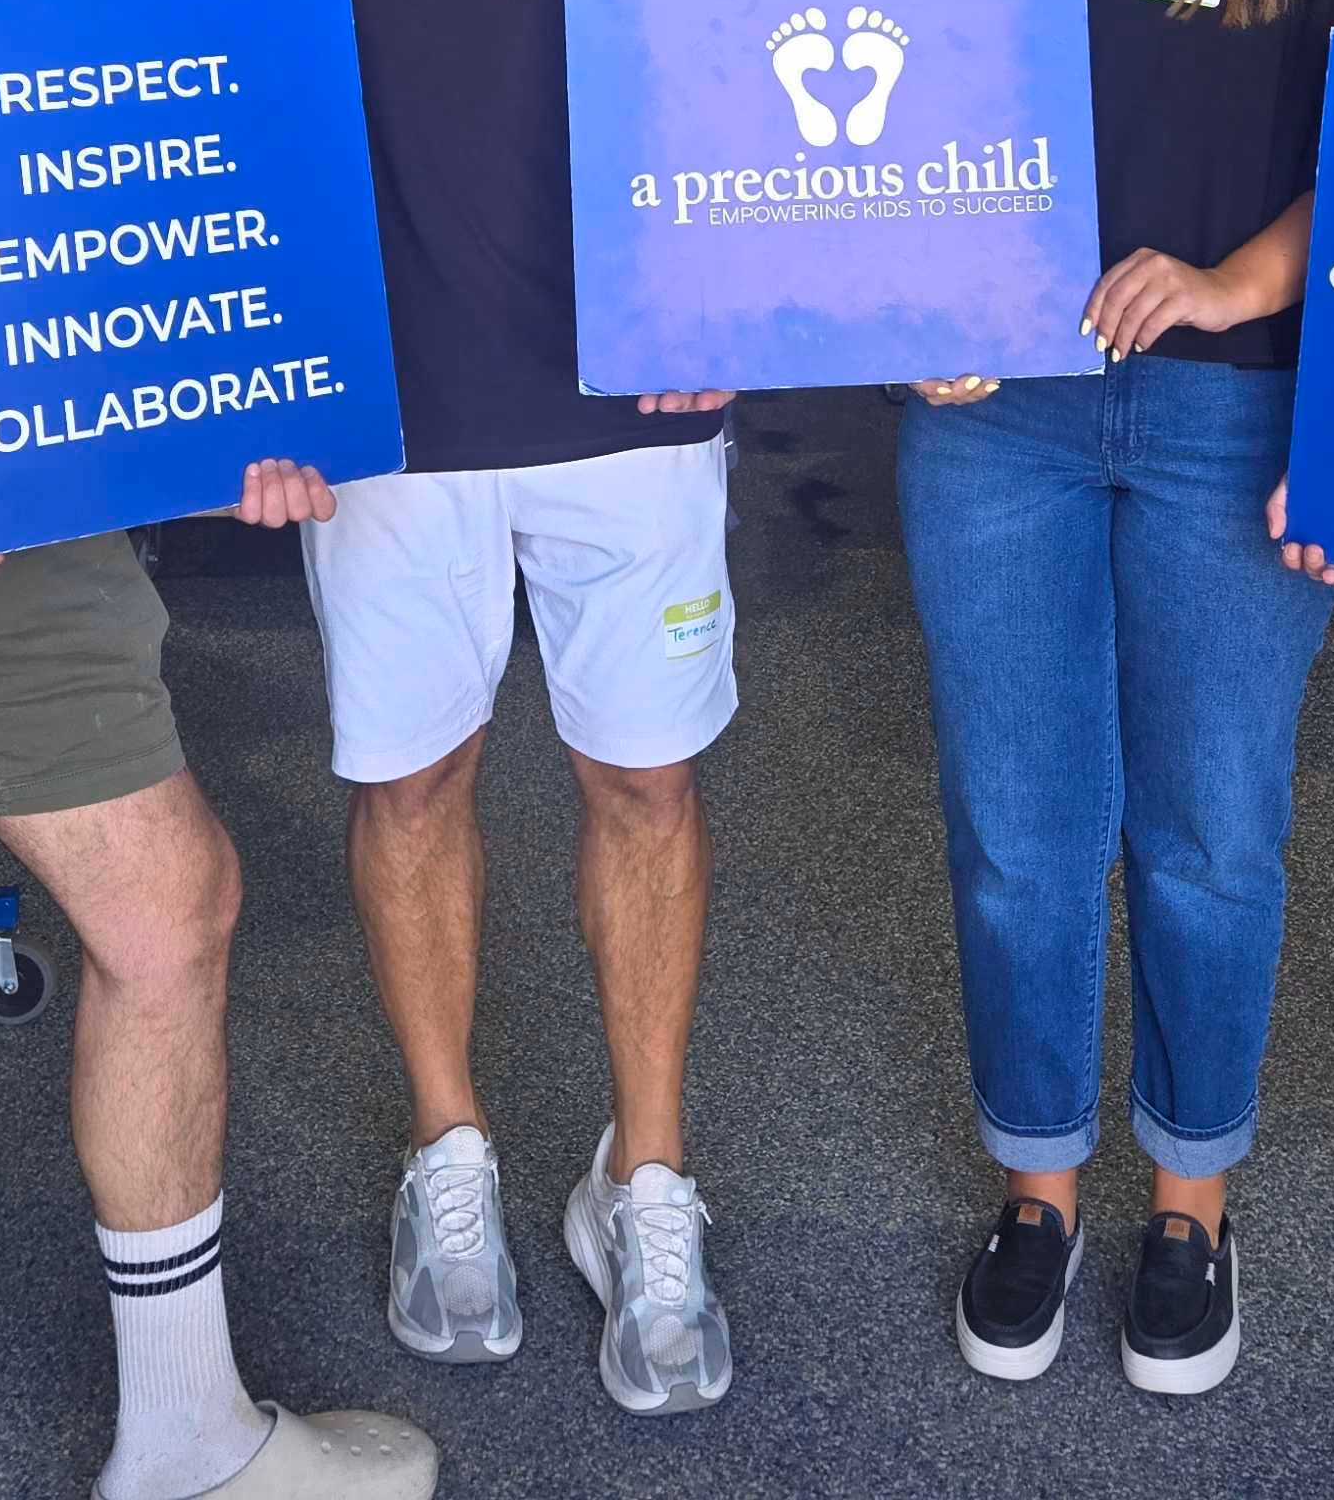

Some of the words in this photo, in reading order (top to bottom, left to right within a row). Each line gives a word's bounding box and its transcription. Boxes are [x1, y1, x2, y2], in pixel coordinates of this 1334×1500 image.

[19, 134, 237, 196] INSPIRE.
[631, 173, 661, 207] a
[673, 152, 905, 225] precious
[917, 137, 1054, 194] child
[709, 203, 856, 225] EMPOWERING
[863, 200, 912, 218] KIDS
[917, 199, 946, 217] TO
[954, 194, 1053, 215] SUCCEED
[5, 286, 283, 366] INNOVATE.
[667, 619, 716, 642] Terence
